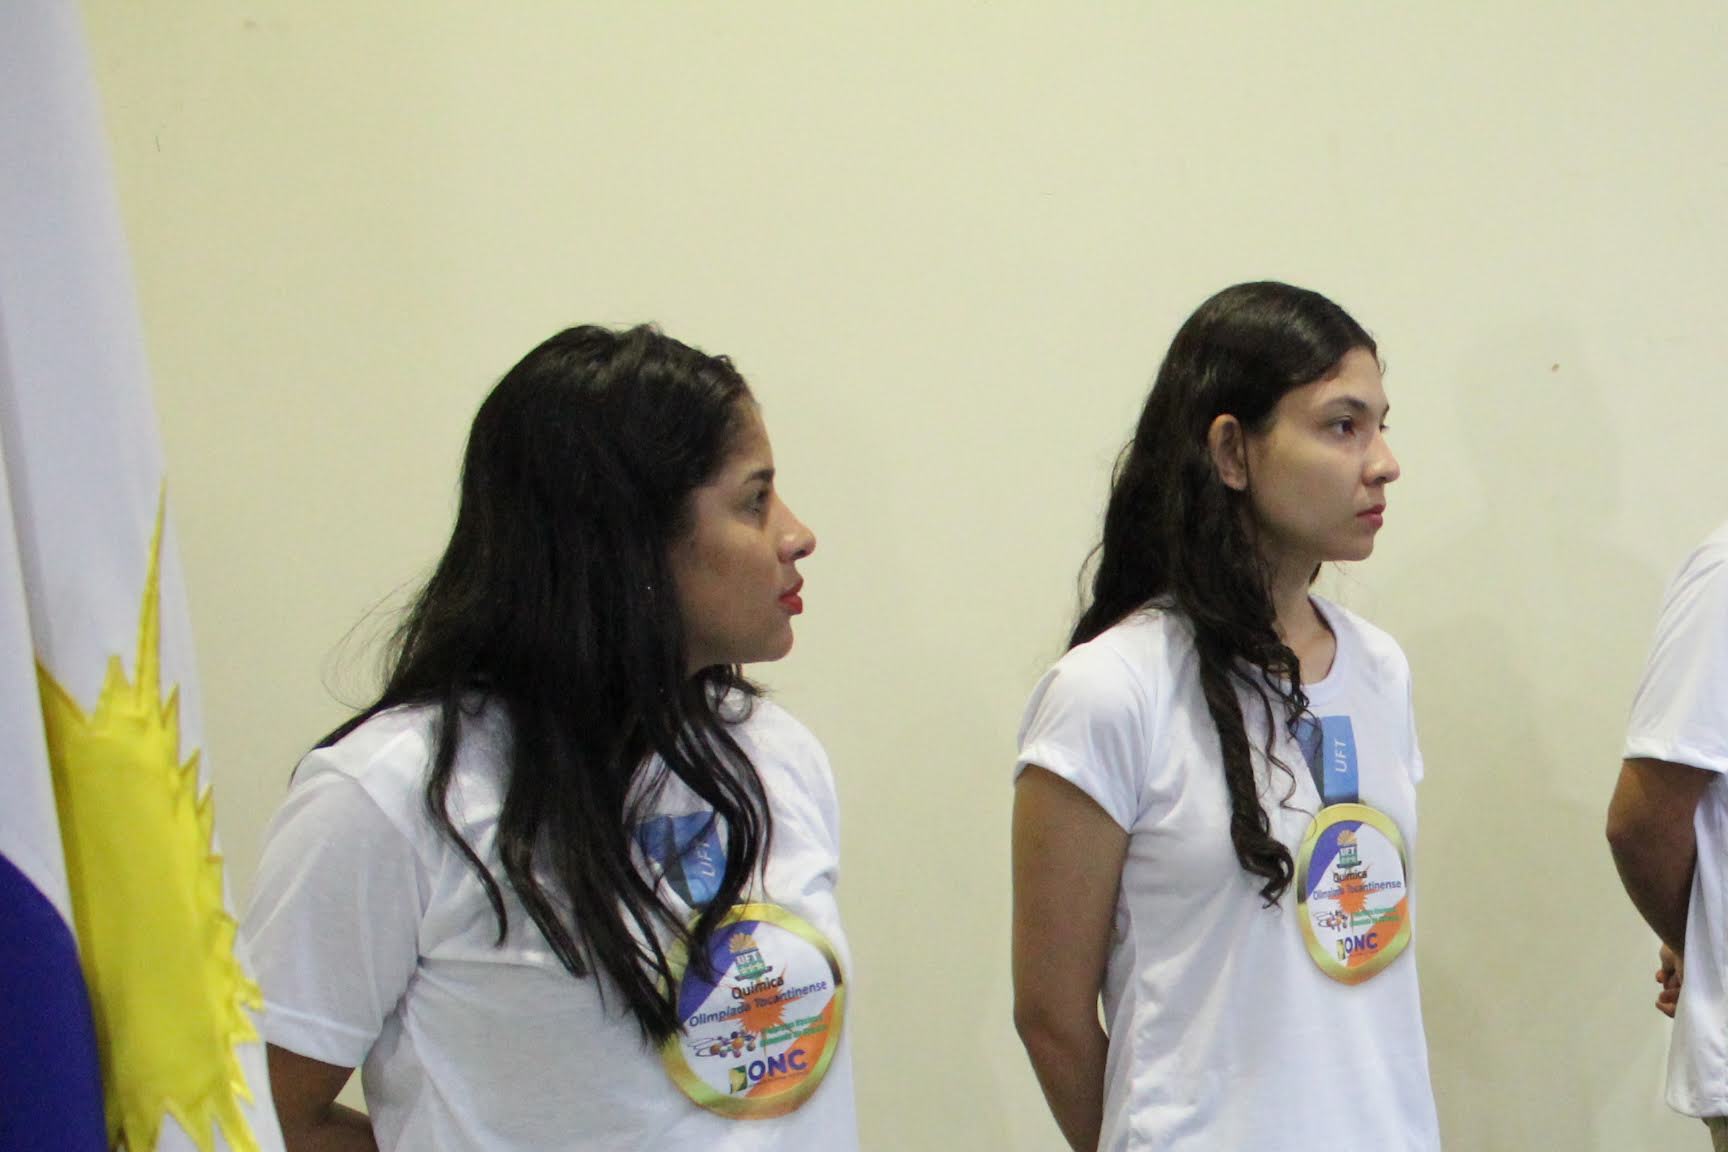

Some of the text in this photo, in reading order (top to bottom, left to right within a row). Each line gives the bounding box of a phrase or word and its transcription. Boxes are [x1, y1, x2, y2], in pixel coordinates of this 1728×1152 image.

[1335, 739, 1347, 773] UFT
[1345, 932, 1378, 954] ONC
[748, 1049, 808, 1081] ONC
